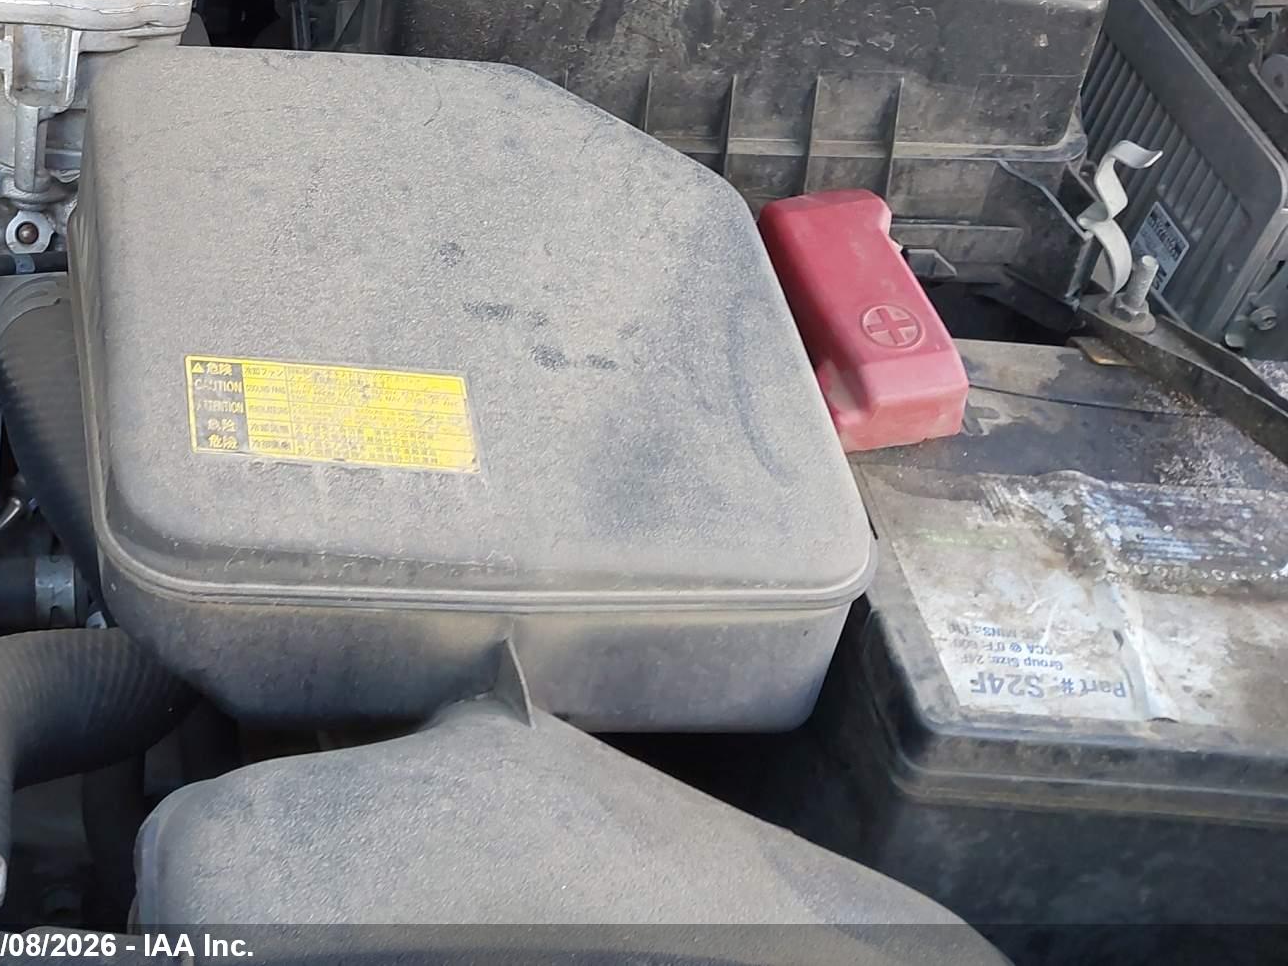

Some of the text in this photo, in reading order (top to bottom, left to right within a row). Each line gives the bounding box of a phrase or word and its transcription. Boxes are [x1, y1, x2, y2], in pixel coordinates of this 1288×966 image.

[194, 378, 242, 393] CAUTION
[195, 399, 244, 414] ATTENTION
[1023, 657, 1064, 671] Group
[969, 671, 1045, 698] S24F
[1078, 678, 1127, 698] Part
